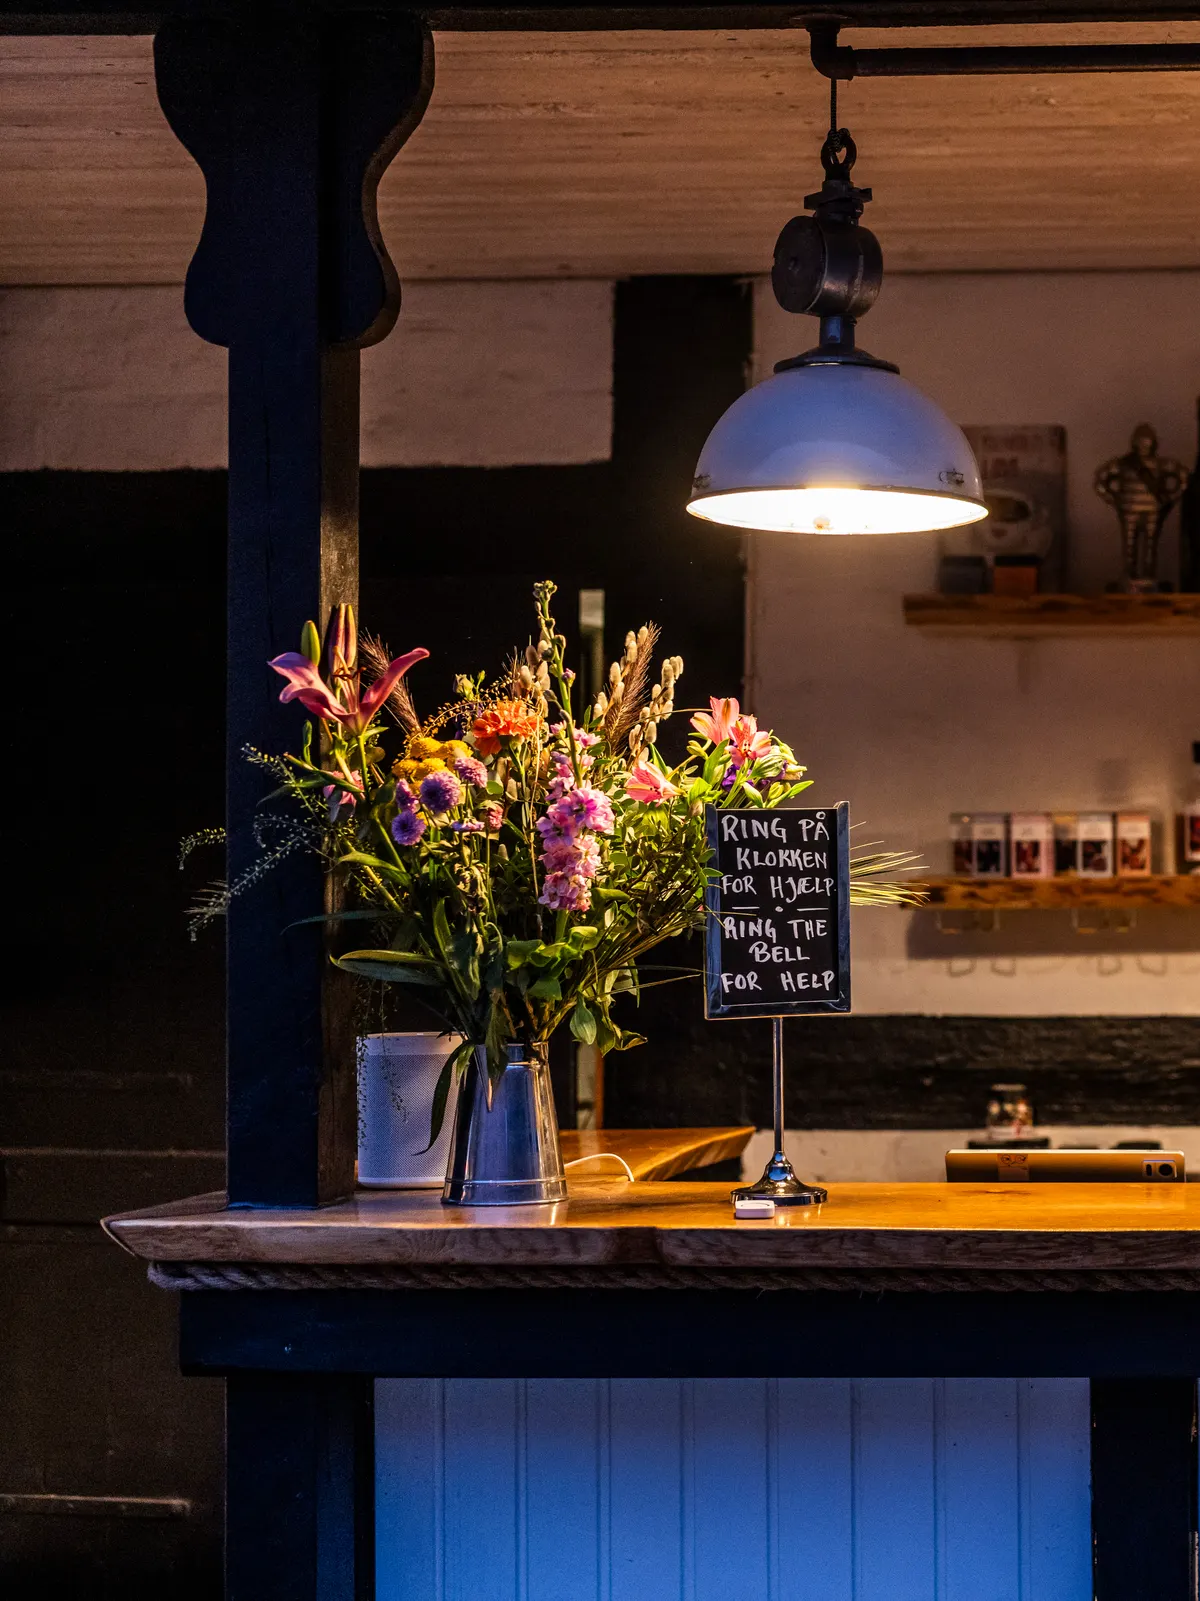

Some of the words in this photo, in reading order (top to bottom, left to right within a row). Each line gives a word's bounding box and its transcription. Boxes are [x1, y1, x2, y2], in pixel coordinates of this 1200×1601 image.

[721, 814, 787, 844] RING
[798, 811, 830, 842] PÅ
[736, 847, 827, 871] KLOKKEN
[721, 874, 757, 896] FOR
[722, 915, 777, 944] RING
[786, 918, 828, 941] THE
[748, 940, 810, 963] BELL
[720, 971, 762, 993] FOR
[780, 970, 836, 992] HELP
